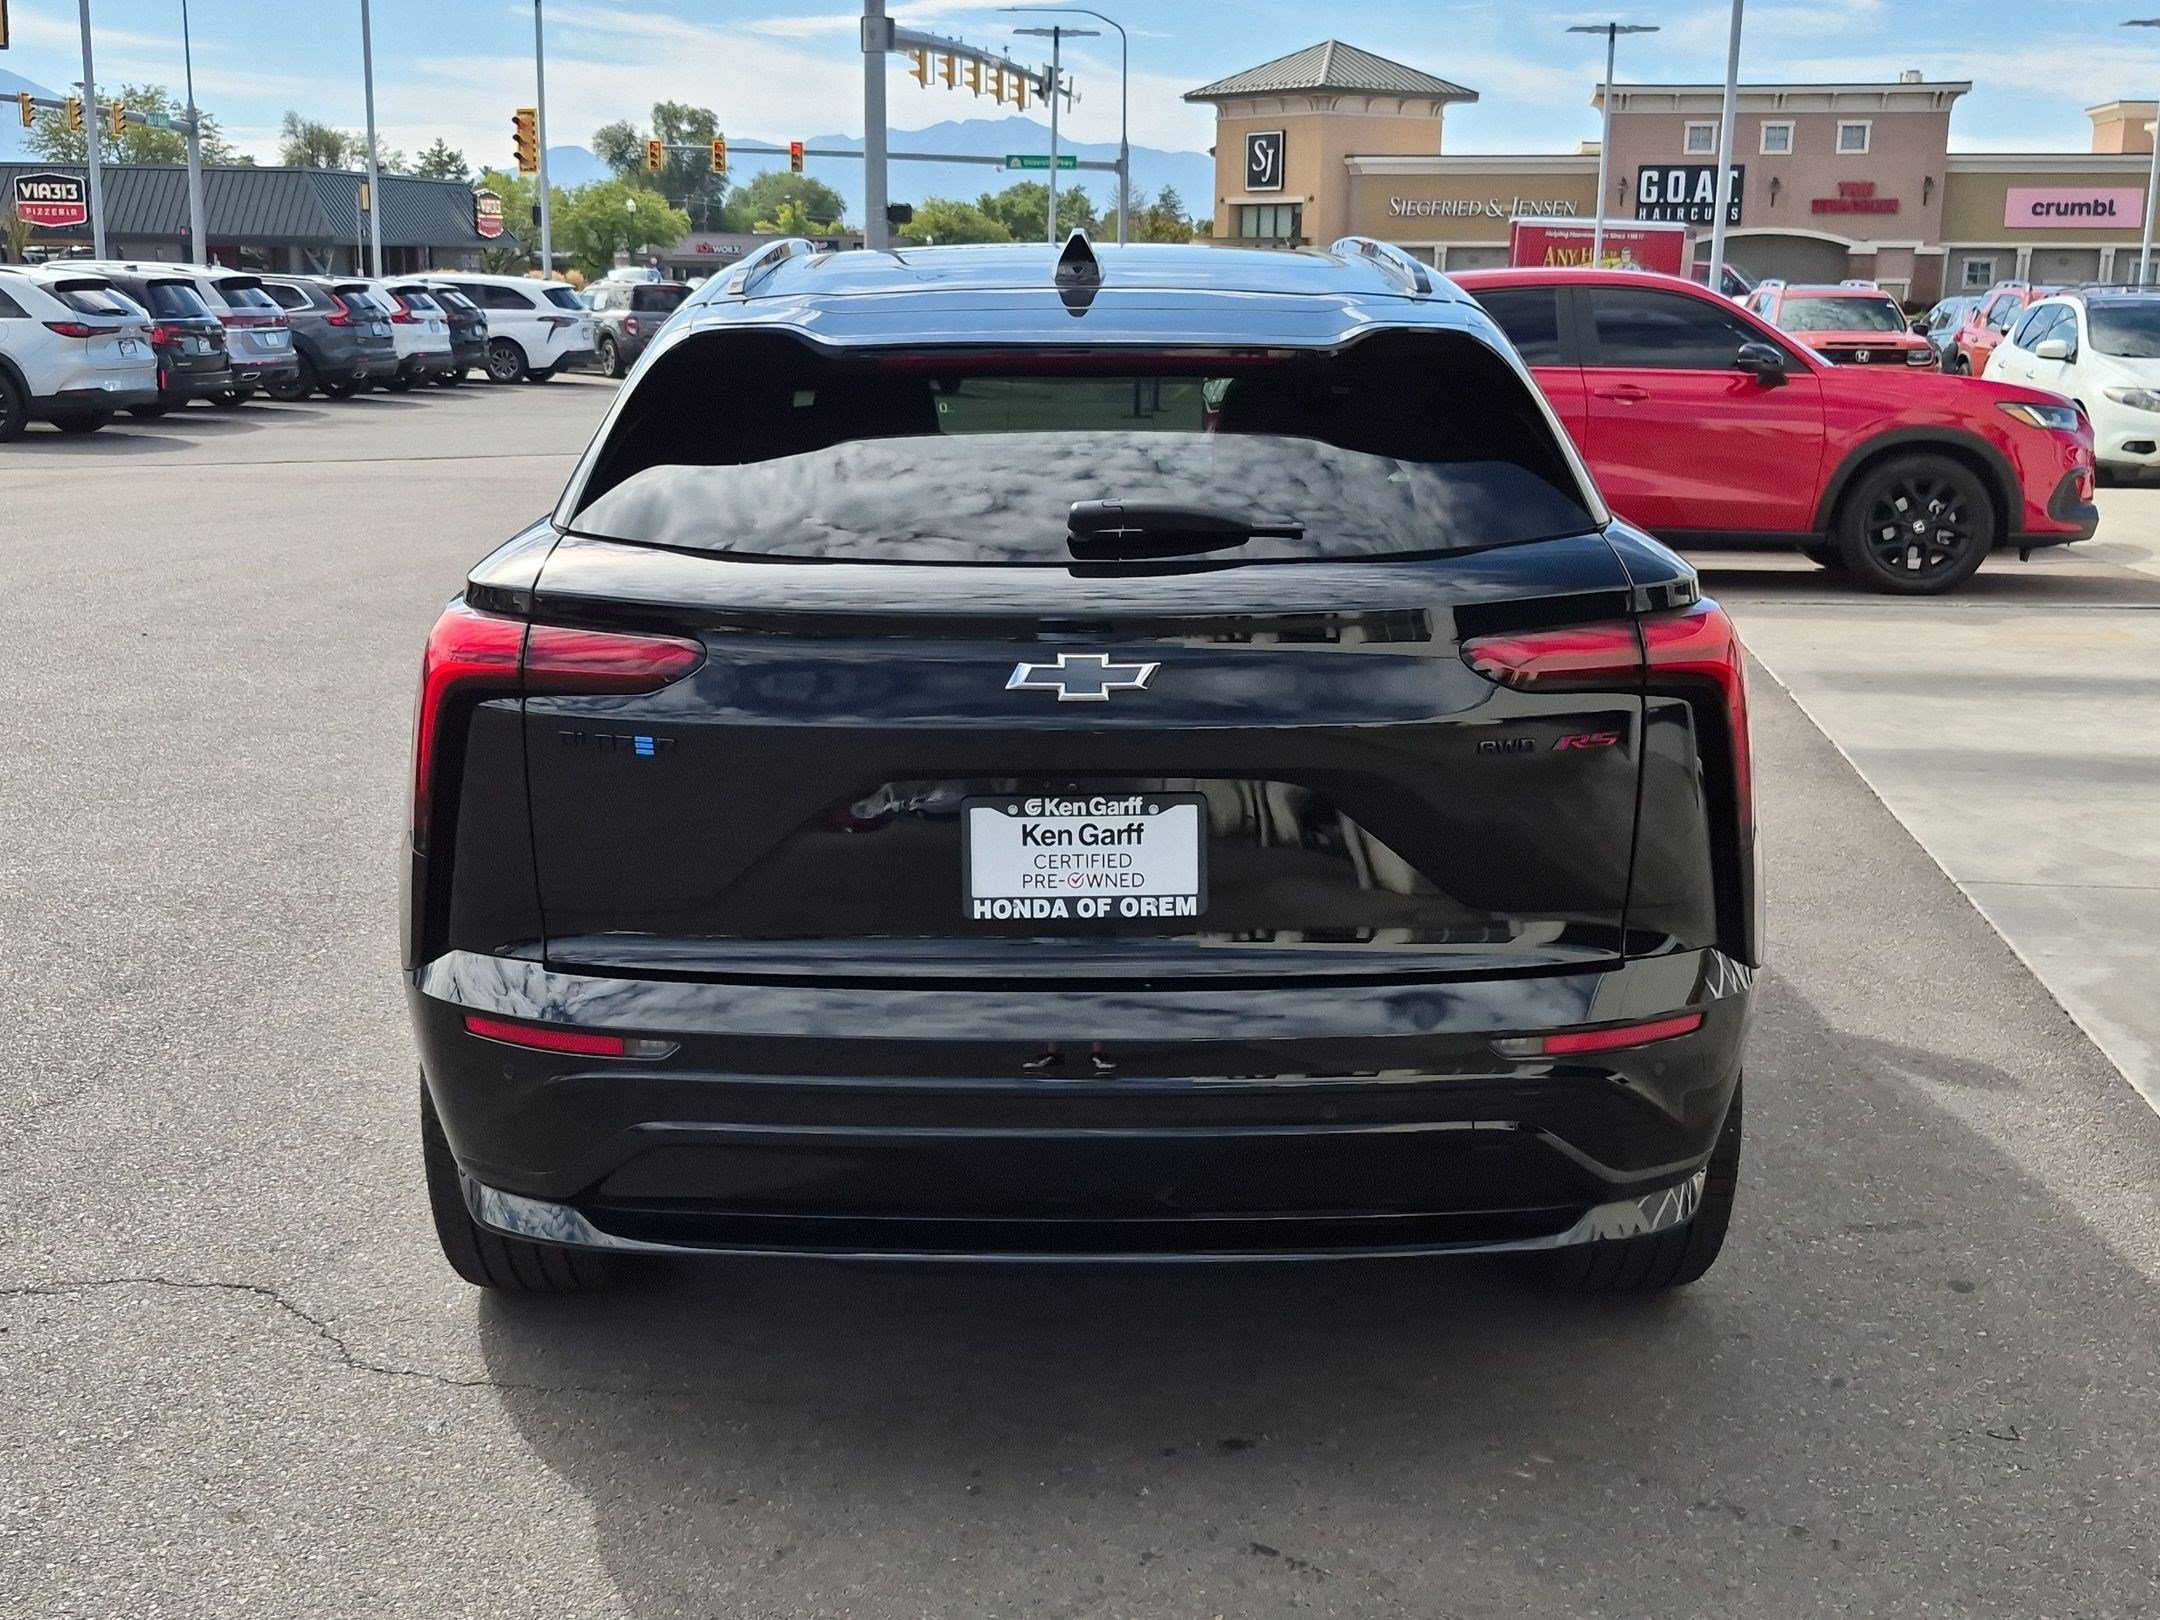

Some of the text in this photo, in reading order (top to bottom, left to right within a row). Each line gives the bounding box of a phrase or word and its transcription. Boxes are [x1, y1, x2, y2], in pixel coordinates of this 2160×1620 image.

[19, 183, 78, 199] VIA313
[1640, 170, 1739, 203] G.O.AT.
[26, 208, 78, 216] PIZZERIA
[1389, 196, 1577, 217] SIEGFRIED & JENSEN
[1639, 207, 1738, 220] HAIRCUS
[2031, 199, 2116, 216] crumbl
[1543, 246, 1580, 267] ANY
[1553, 730, 1621, 752] RS
[1045, 797, 1143, 816] Ken Garff
[1022, 822, 1144, 846] Ken Garff
[1034, 853, 1132, 869] CERTIFIED
[1022, 872, 1145, 889] PRE-OWNED
[973, 896, 1197, 919] HONDA OF OREM
